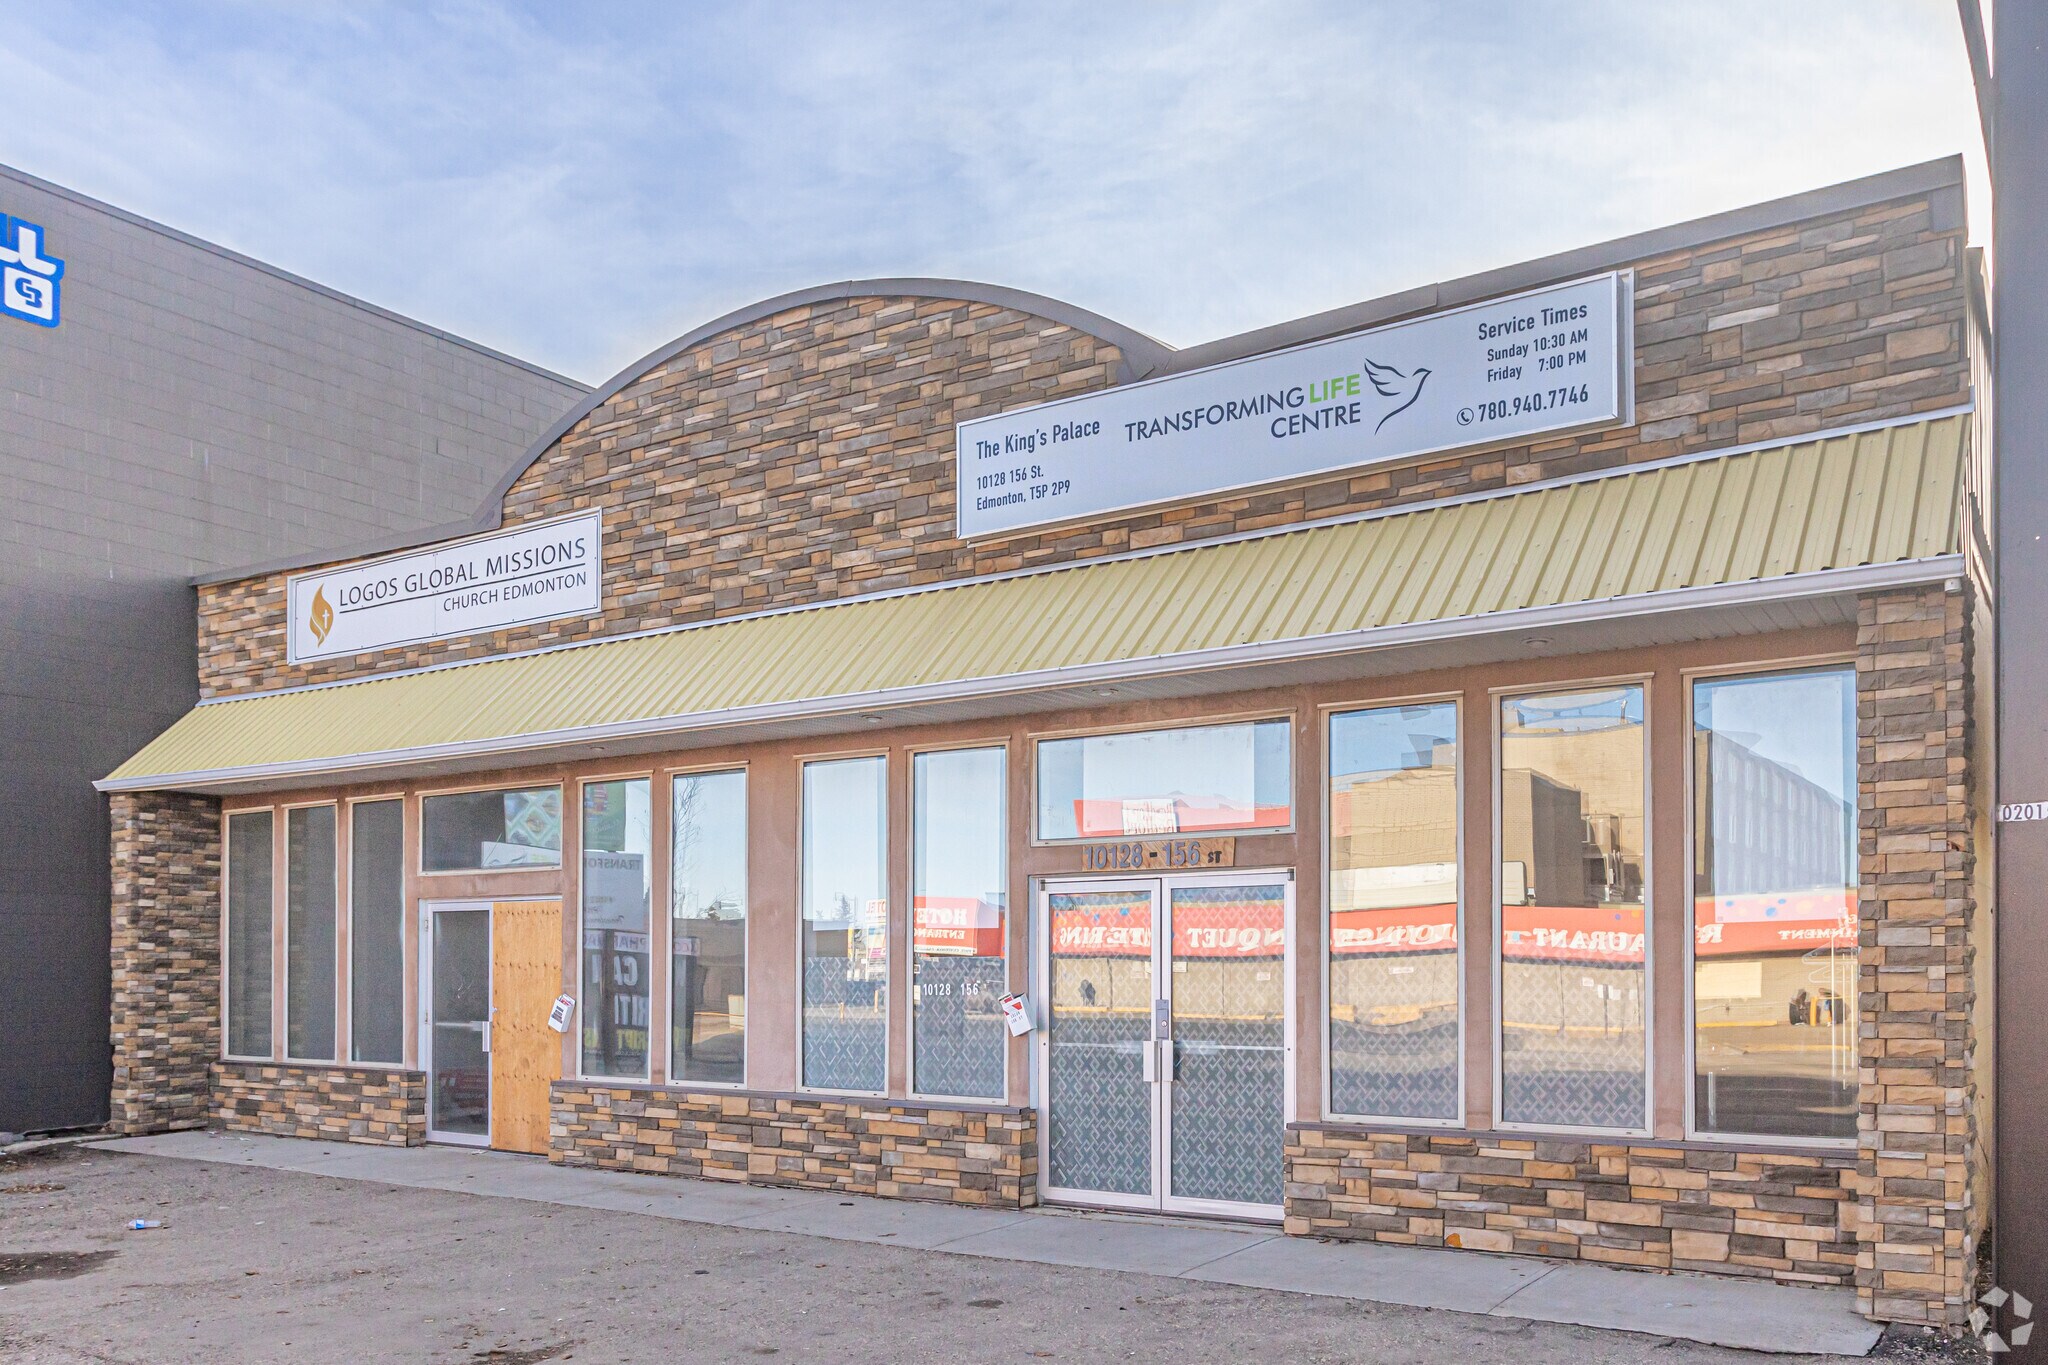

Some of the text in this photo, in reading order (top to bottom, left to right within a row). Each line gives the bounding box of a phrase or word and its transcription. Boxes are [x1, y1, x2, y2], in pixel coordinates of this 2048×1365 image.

[1478, 304, 1588, 341] Service Times
[1487, 328, 1588, 363] Sunday 10:30 AM
[1487, 350, 1587, 383] Friday 7:00 PM
[1270, 402, 1361, 439] CENTRE
[1478, 384, 1589, 423] 780.940.7746
[976, 439, 1000, 460] The
[1052, 418, 1100, 444] Palace
[976, 464, 1044, 490] 10128 156 St.
[976, 479, 1071, 511] Edmonton, T5P 2P9
[339, 537, 586, 607] LOGOS GLOBAL MISSIONS
[443, 572, 587, 612] CHURCH EDMONTON
[1085, 844, 1144, 870] 10128
[1163, 841, 1200, 867] 156
[1207, 850, 1223, 864] ST
[923, 983, 979, 996] 10128 156
